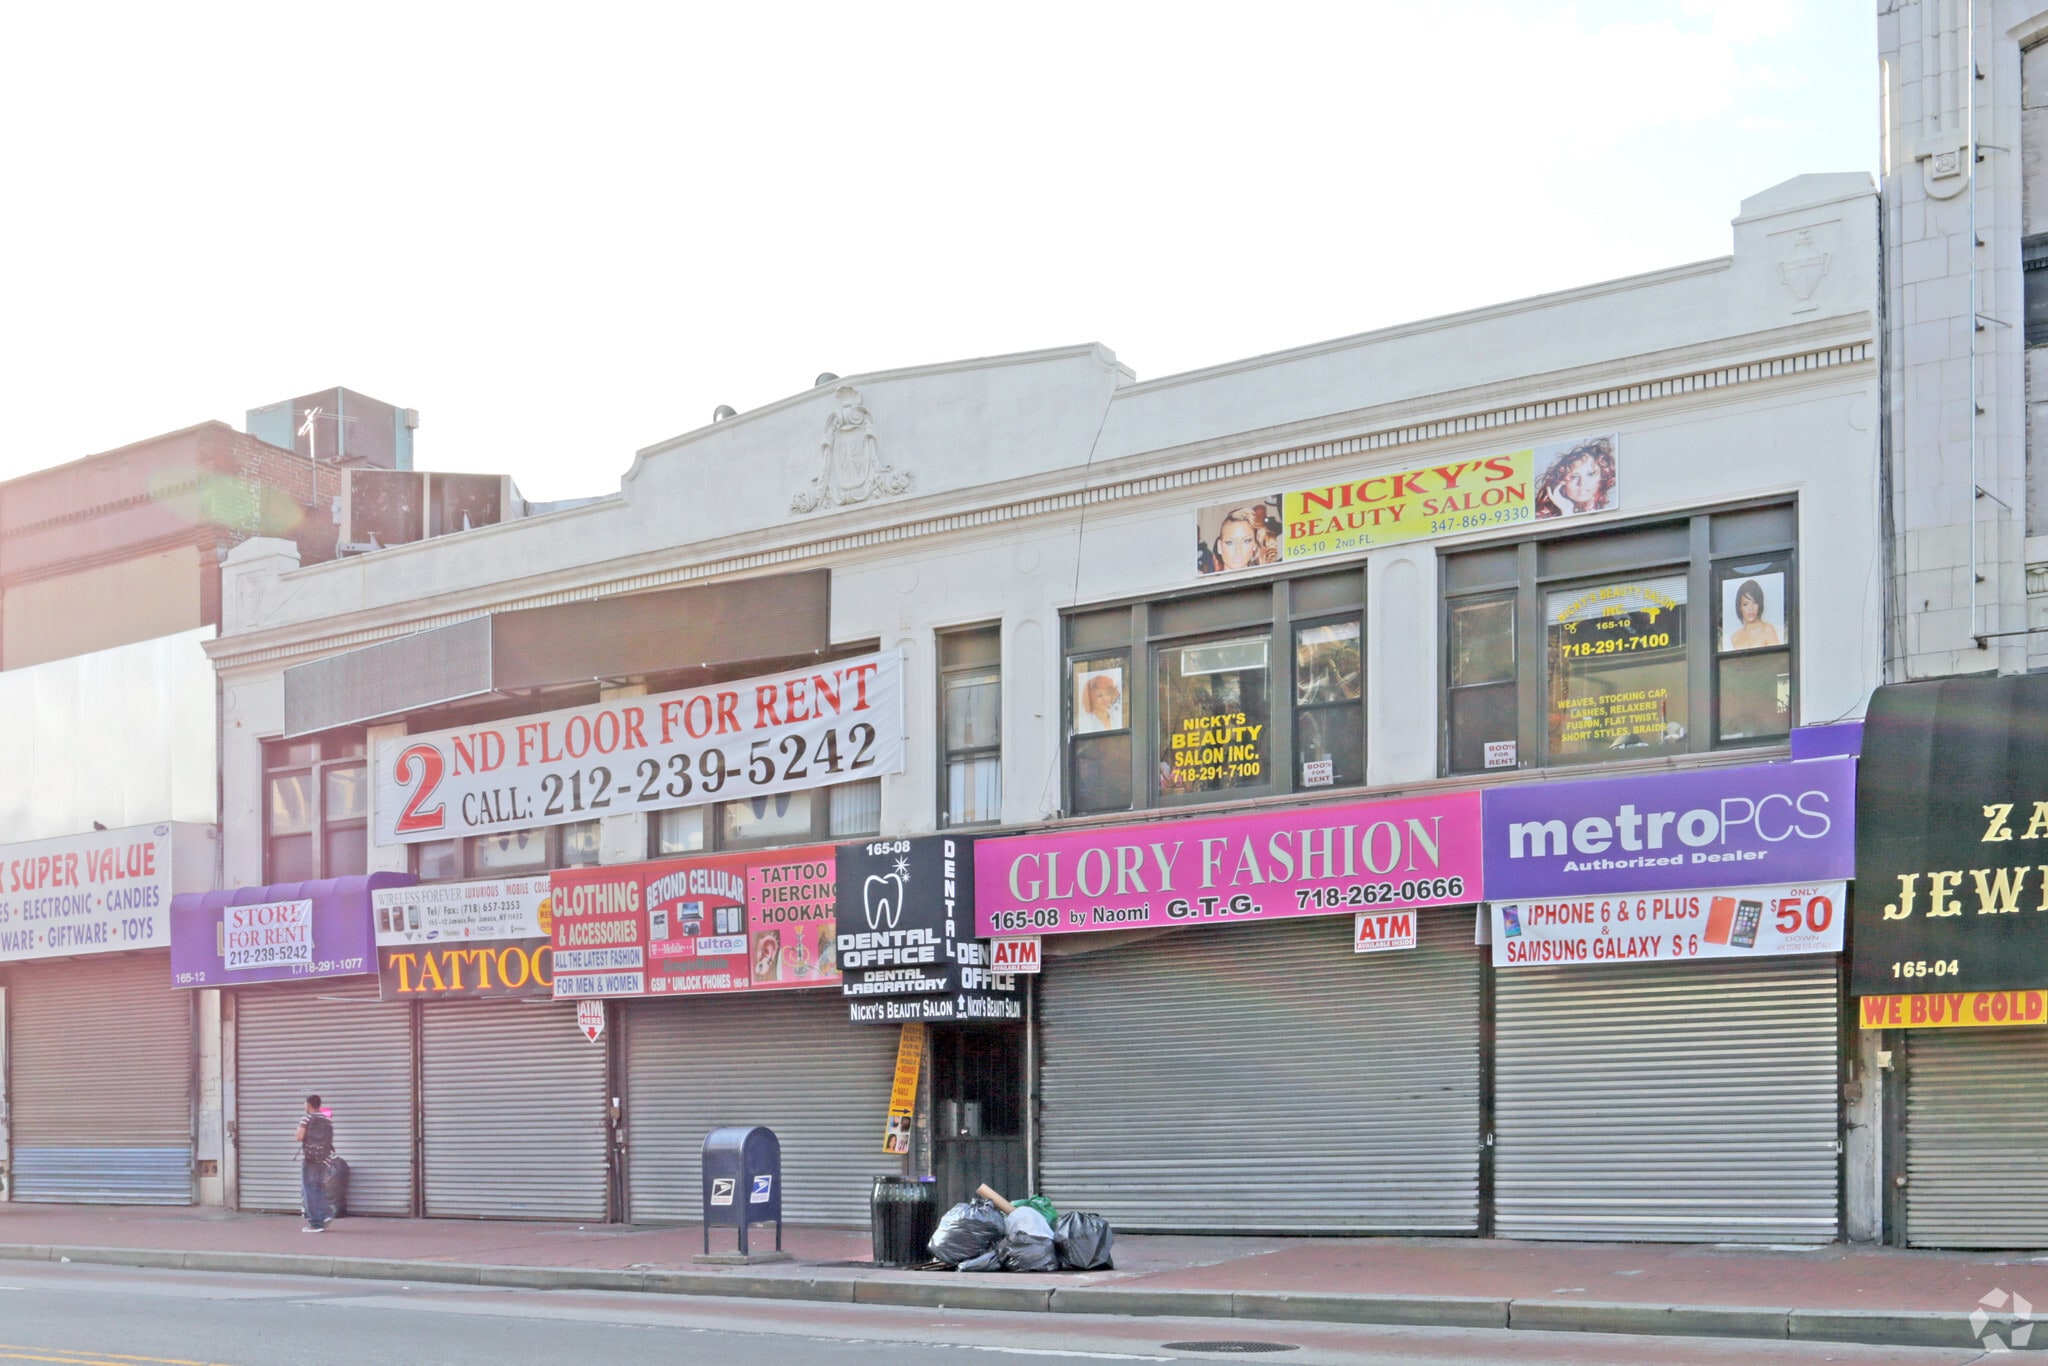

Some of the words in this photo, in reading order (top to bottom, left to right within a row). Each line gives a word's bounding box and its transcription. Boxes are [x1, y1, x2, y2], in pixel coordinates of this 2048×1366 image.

[1300, 456, 1514, 514] NICKY'S
[1289, 504, 1406, 539] BEAUTY
[1423, 483, 1526, 517] SALON
[1430, 506, 1529, 533] 347-869-9330
[1288, 541, 1326, 556] 165-10
[1600, 585, 1641, 600] BEAUTY
[1644, 588, 1676, 612] SALON
[1596, 620, 1630, 630] 165-10
[1562, 633, 1669, 658] 718-291-7100
[1599, 691, 1645, 704] STOCKING
[1610, 701, 1657, 714] RELAXERS
[516, 706, 649, 766] FLOOR
[660, 690, 742, 742] FOR
[754, 663, 878, 730] RENT
[1184, 712, 1246, 730] NICKY'S
[1605, 716, 1627, 726] FLAT
[1172, 725, 1262, 749] BEAUTY
[1562, 731, 1592, 742] SHORT
[1633, 722, 1667, 734] BRAIDS
[1175, 747, 1224, 768] SALON
[1228, 744, 1259, 762] INC.
[462, 787, 533, 828] CALL:
[540, 722, 878, 818] 212-239-5242
[1173, 762, 1260, 782] 718-291-7100
[1509, 790, 1831, 859] metroPCS
[866, 840, 910, 856] 165-08
[11, 852, 79, 892] SUPER
[86, 842, 156, 886] VALUE
[1008, 841, 1184, 903] GLORY
[1198, 816, 1445, 889] FASHION
[1563, 854, 1684, 872] Authorized
[1691, 849, 1768, 864] Dealer
[761, 862, 828, 884] TATTOO
[378, 891, 420, 906] WIRELESS
[422, 888, 462, 903] FOREVER
[465, 885, 498, 898] LUXURIOUS
[506, 883, 528, 896] MOBILE
[552, 880, 640, 918] CLOTHING
[646, 872, 686, 912] BEYOND
[690, 869, 744, 904] CELLULAR
[944, 840, 955, 958] DENTAL
[1790, 888, 1819, 896] ONLY
[23, 893, 92, 921] ELECTRONIC
[106, 885, 160, 912] CANDIES
[482, 900, 520, 912] 657-2353
[990, 909, 1059, 930] 165-08
[1070, 909, 1087, 926] by
[1092, 902, 1149, 924] Naomi
[1166, 894, 1263, 918] G.T.G.
[1296, 876, 1464, 910] 718-262-0666
[1528, 902, 1594, 926] iPHONE
[1600, 900, 1610, 922] 6
[1617, 900, 1630, 922] &
[1636, 898, 1646, 920] 6
[1653, 896, 1700, 920] PLUS
[232, 903, 302, 928] STORE
[48, 921, 108, 948] GIFTWARE
[122, 917, 153, 941] TOYS
[229, 930, 260, 949] FOR
[265, 924, 308, 944] RENT
[559, 924, 566, 946] &
[569, 919, 637, 946] ACCESSORIES
[837, 928, 942, 950] DENTAL
[1360, 915, 1411, 941] ATM
[1601, 926, 1610, 935] &
[230, 944, 307, 966] 212-239-5242
[698, 938, 732, 950] ultra
[994, 942, 1036, 963] ATM
[1358, 941, 1390, 949] AVAILABLE
[1507, 939, 1588, 963] SAMSUNG
[1592, 935, 1661, 960] GALAXY
[1672, 935, 1684, 958] S
[1688, 934, 1698, 956] 6
[555, 954, 567, 968] ALL
[569, 952, 582, 968] THE
[584, 950, 608, 967] LATEST
[610, 948, 640, 966] FASHION
[843, 946, 934, 968] OFFICE
[175, 971, 206, 984] 165-12
[864, 968, 925, 982] DENTAL
[962, 967, 1015, 990] OFFICE
[1892, 960, 1959, 978] 165-04
[557, 978, 574, 994] FOR
[576, 977, 594, 993] MEN
[597, 976, 604, 992] &
[606, 975, 638, 992] WOMEN
[651, 977, 666, 992] GSM
[672, 975, 701, 992] UNLOCK
[702, 974, 730, 990] PHONES
[844, 978, 947, 995] LABORATORY
[580, 1000, 601, 1016] ATM
[887, 1000, 920, 1018] BEAUTY
[923, 999, 952, 1018] SALON
[1863, 996, 1902, 1024] WE
[1910, 994, 1965, 1024] BUY
[1973, 991, 2042, 1022] GOLD
